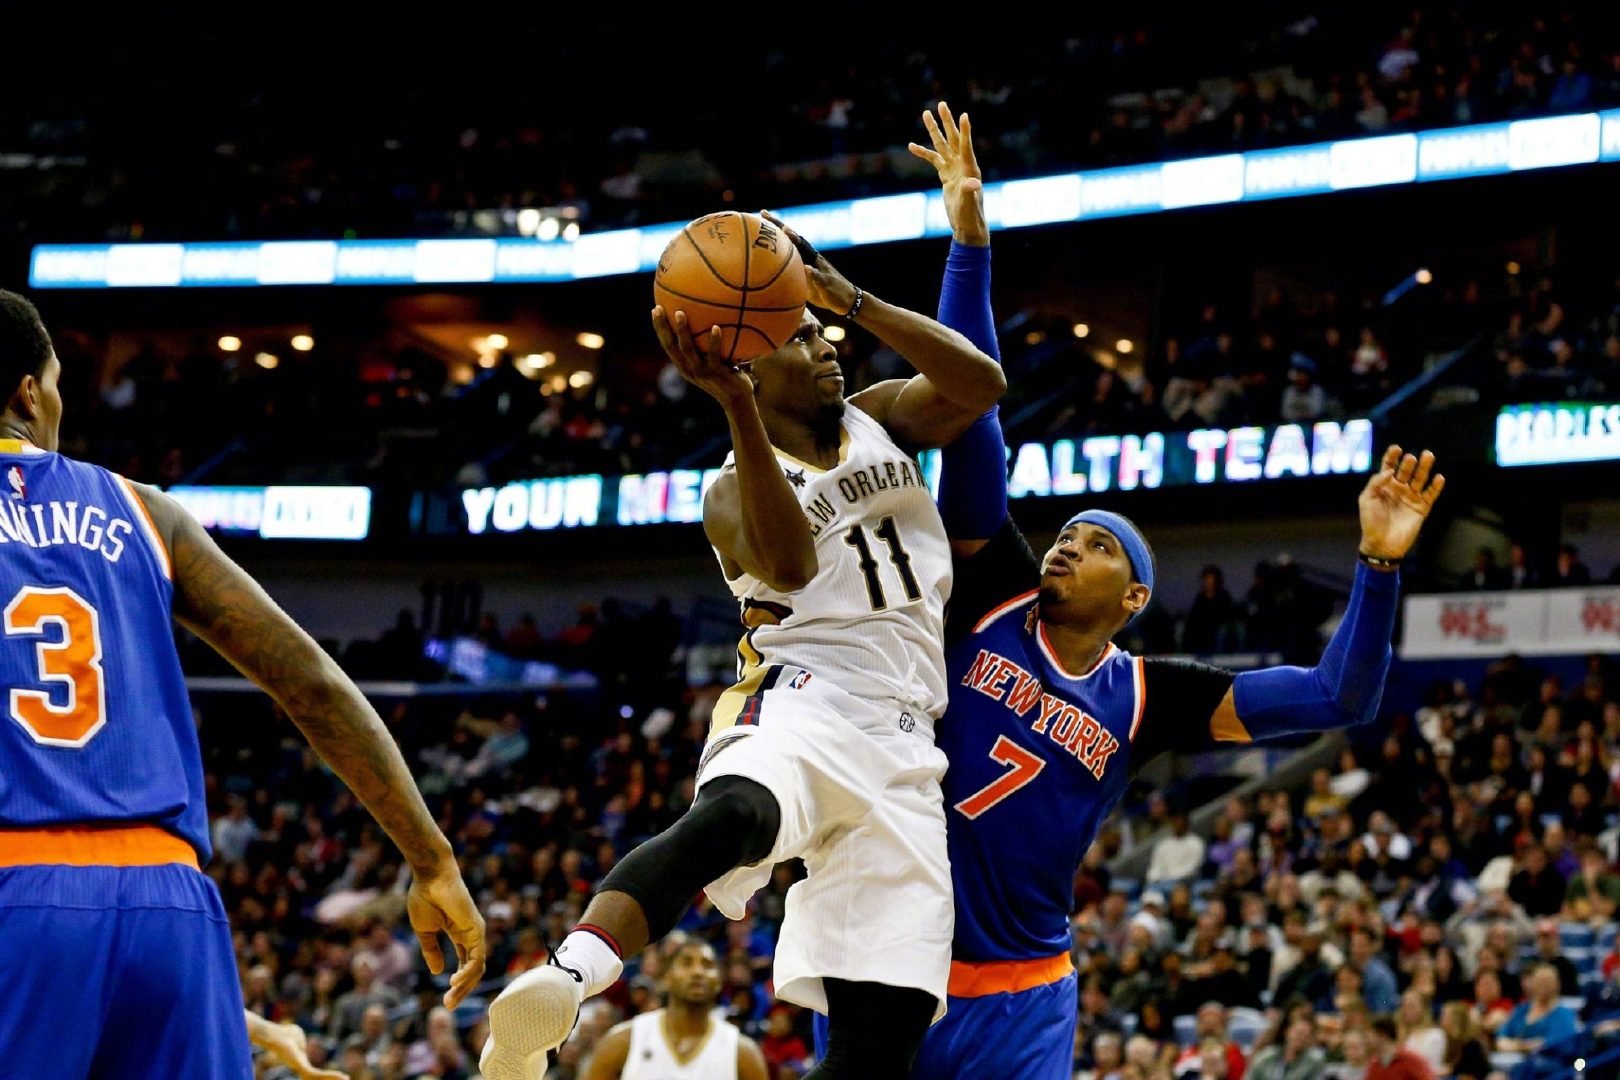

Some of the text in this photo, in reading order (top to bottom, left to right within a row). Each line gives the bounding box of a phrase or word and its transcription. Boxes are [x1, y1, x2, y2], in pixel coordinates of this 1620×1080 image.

[462, 474, 602, 534] YOUR
[618, 469, 722, 526] ME
[1187, 418, 1373, 484] TEAM
[843, 514, 924, 612] 11
[3, 585, 107, 748] 3
[961, 649, 1119, 781] NEW YORK
[953, 734, 1047, 820] 7
